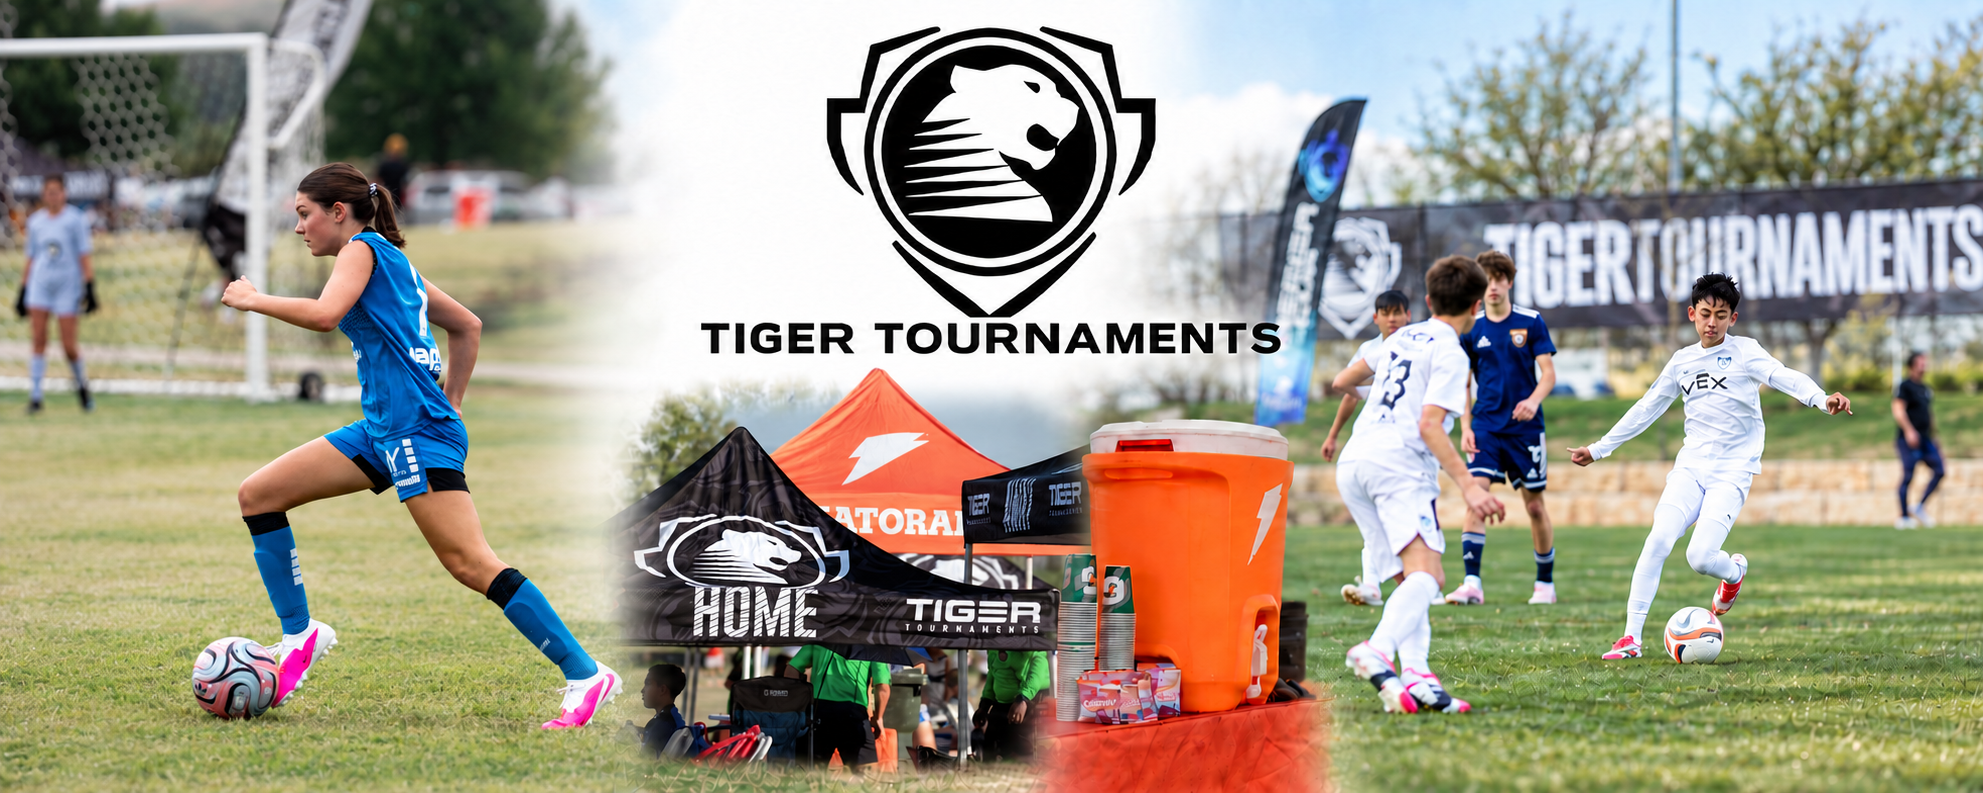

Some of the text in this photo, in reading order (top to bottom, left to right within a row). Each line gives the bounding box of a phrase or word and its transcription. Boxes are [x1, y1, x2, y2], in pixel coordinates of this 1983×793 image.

[1681, 372, 1728, 396] VEX
[818, 505, 965, 537] ATORA
[692, 586, 819, 638] HOME
[906, 598, 1041, 624] TIGER
[905, 623, 1039, 634] TOURNAMENTS
